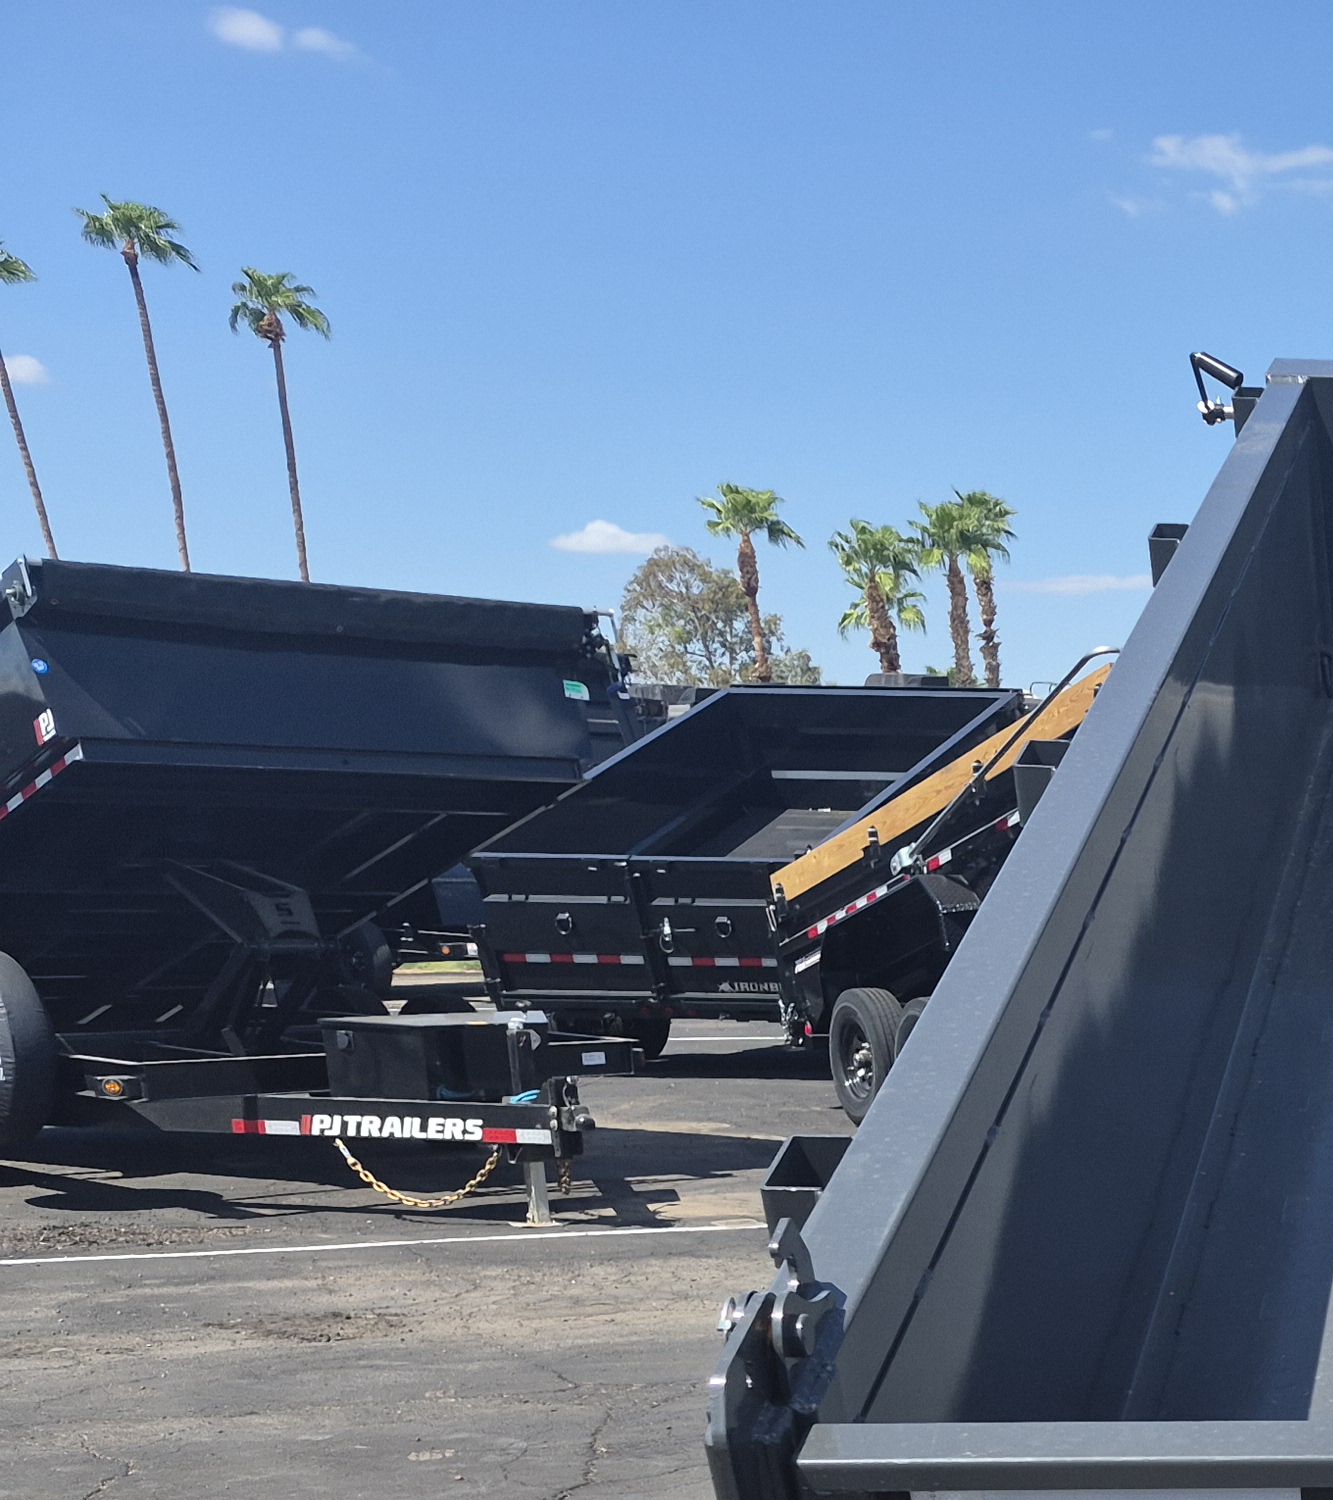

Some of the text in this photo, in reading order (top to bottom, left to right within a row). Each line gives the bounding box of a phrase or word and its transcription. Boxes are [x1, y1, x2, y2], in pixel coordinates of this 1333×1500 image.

[735, 981, 782, 993] IRONB
[311, 1114, 484, 1141] PJ TRAILERS
